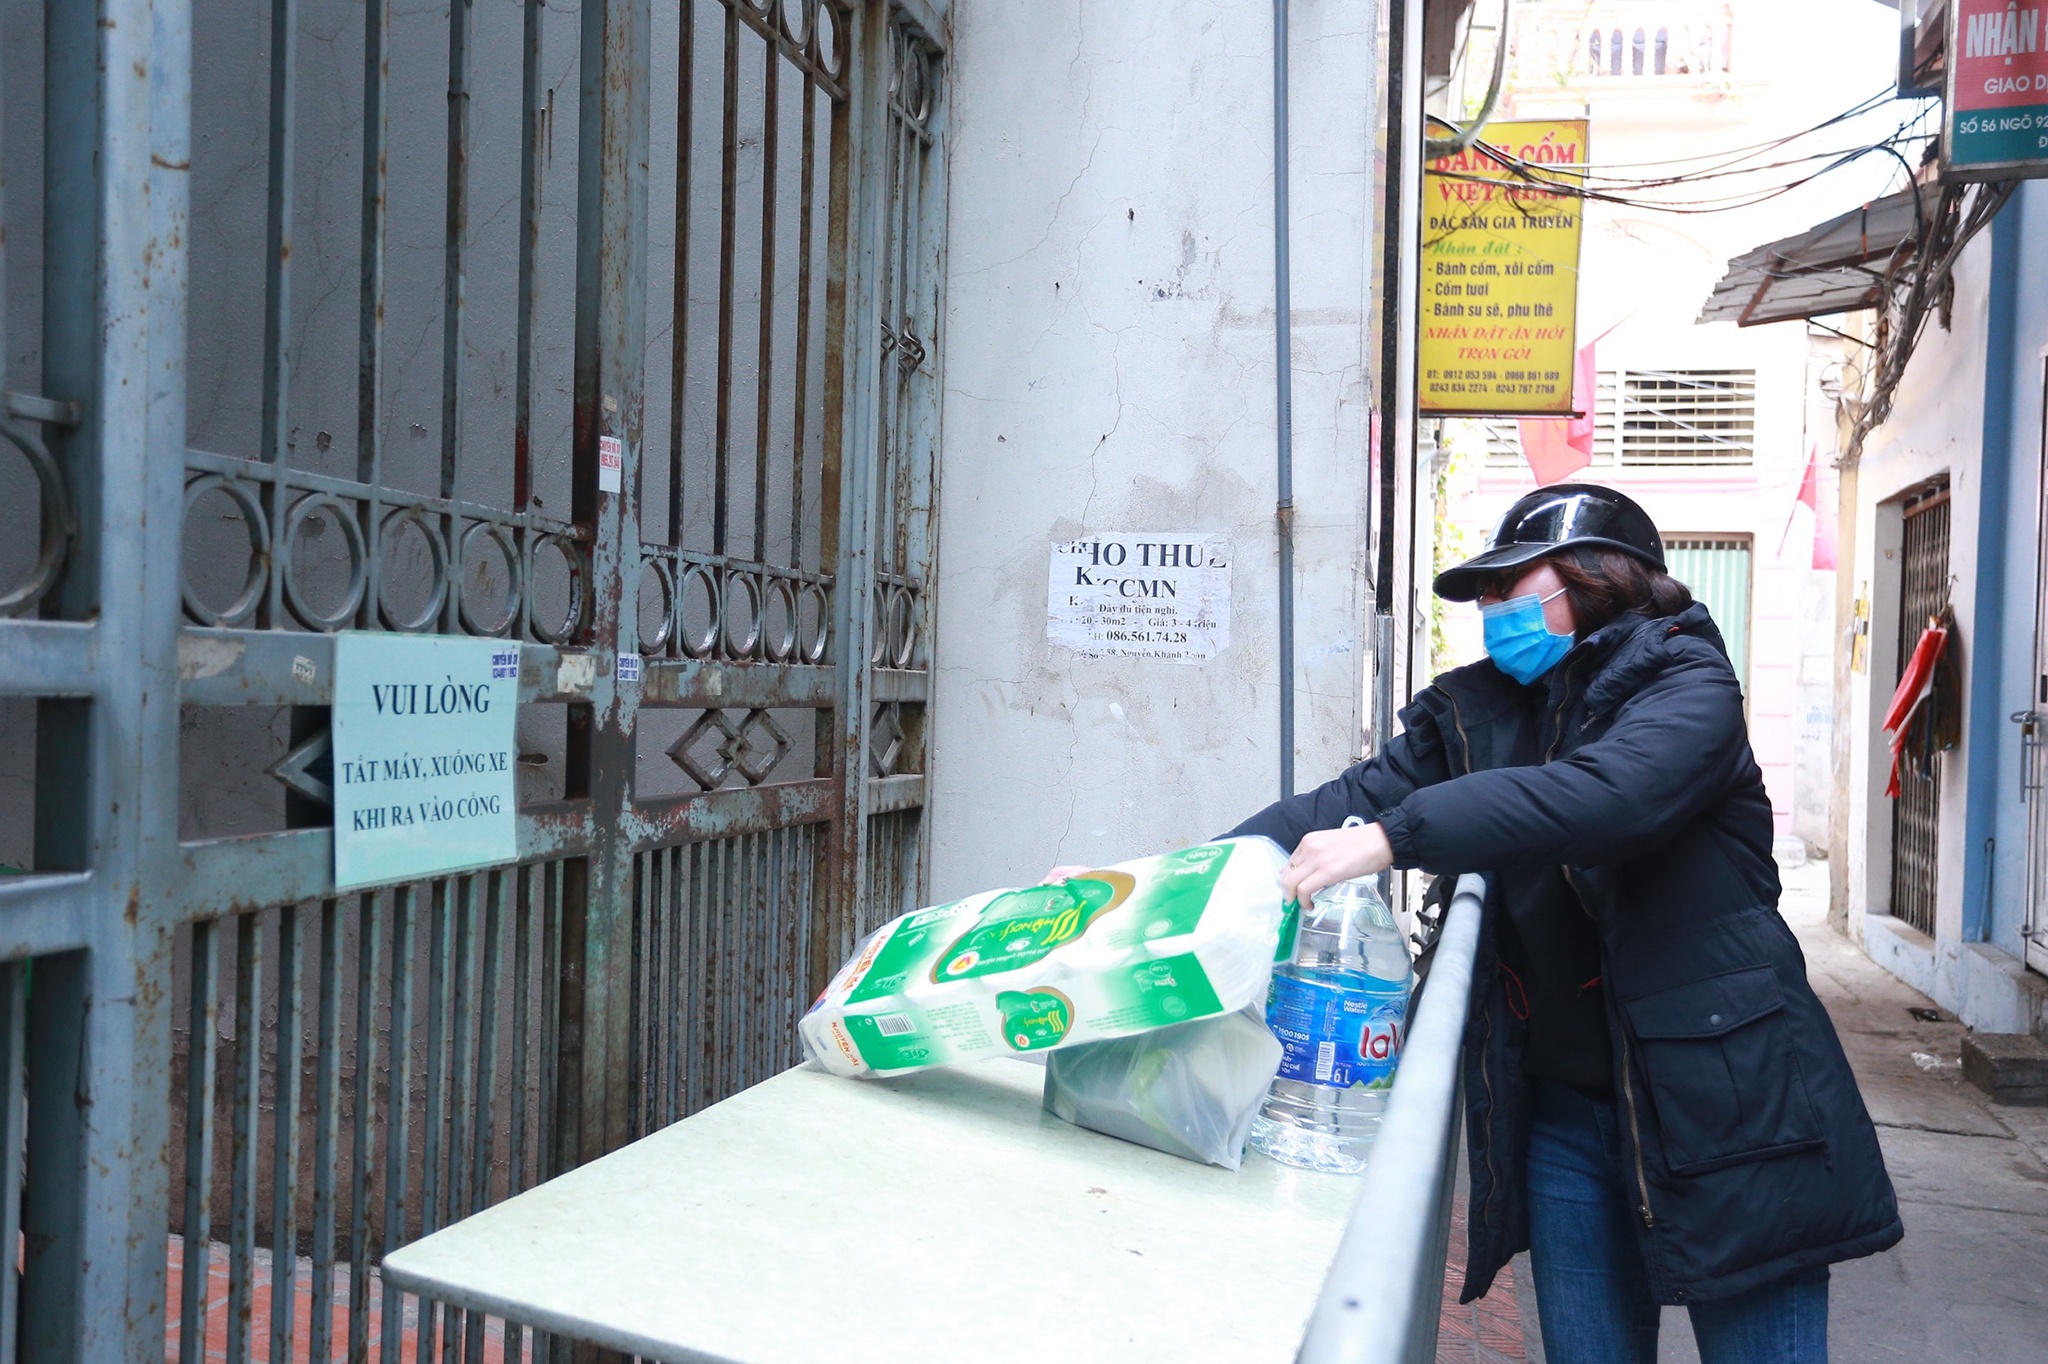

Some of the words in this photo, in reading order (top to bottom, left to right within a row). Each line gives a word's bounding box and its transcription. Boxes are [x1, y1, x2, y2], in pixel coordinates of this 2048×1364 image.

[1965, 1, 2038, 65] NHẬN
[1984, 75, 2030, 94] GIAO
[2035, 74, 2048, 94] D
[1960, 116, 1978, 134] SỐ
[1981, 119, 1996, 132] 56
[2000, 114, 2031, 130] NGÕ
[1492, 217, 1516, 229] GIA
[1433, 241, 1475, 256] Nhận
[1436, 262, 1466, 275] Bánh
[1504, 262, 1523, 275] xôi
[1527, 259, 1554, 275] cốm
[1435, 280, 1462, 296] Cốm
[1434, 303, 1464, 317] Bánh
[1458, 347, 1497, 362] TRỌN
[1100, 616, 1126, 626] 30m2
[1171, 618, 1177, 628] 3
[1185, 619, 1191, 628] 4
[1106, 630, 1187, 643] 086.561.74.28
[373, 685, 417, 715] VUI
[425, 675, 490, 714] LÒNG
[343, 755, 378, 784] TẮT
[384, 752, 427, 781] MÁY,
[431, 749, 485, 777] XUỐNG
[489, 752, 508, 771] XE
[353, 808, 386, 831] KHI
[391, 806, 414, 826] RA
[419, 796, 452, 822] VÀO
[457, 792, 500, 818] CỔNG
[1343, 1006, 1368, 1014] Waters
[1360, 1022, 1402, 1059] laV
